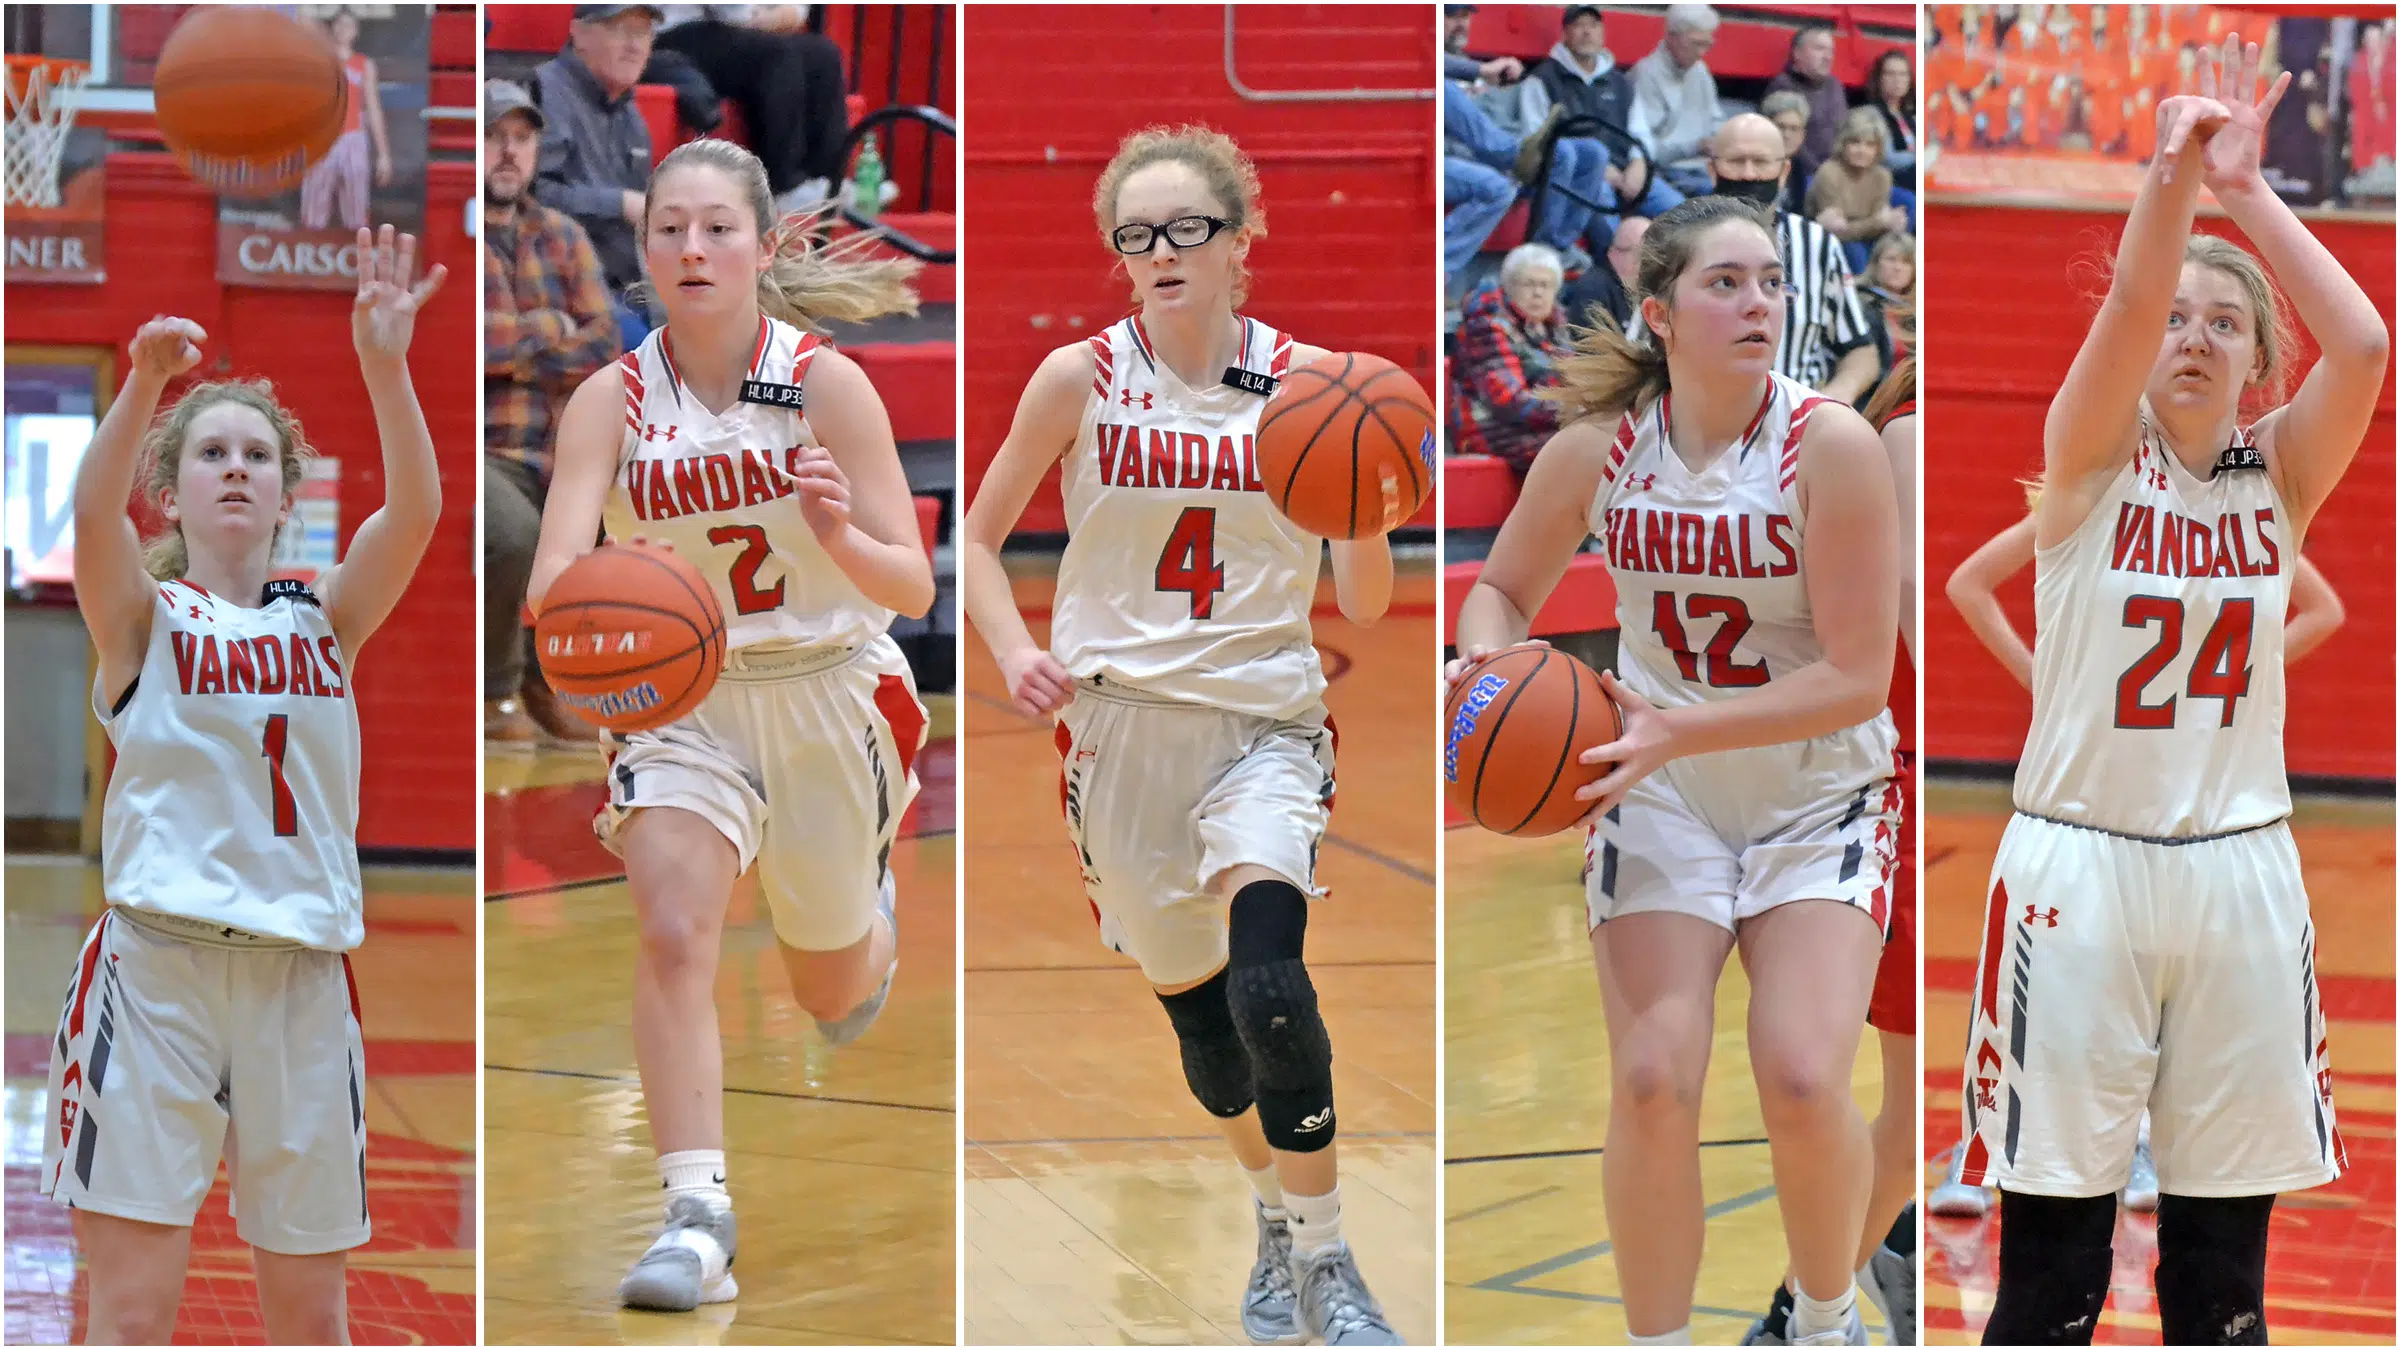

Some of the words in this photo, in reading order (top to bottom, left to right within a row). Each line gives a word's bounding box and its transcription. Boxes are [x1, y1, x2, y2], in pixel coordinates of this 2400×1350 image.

[4, 234, 88, 270] NER
[239, 234, 394, 278] CARSO
[748, 384, 775, 400] HL14
[1240, 372, 1265, 391] HL14
[1097, 423, 1265, 492] VANDAL
[707, 524, 786, 616] 2
[1155, 506, 1225, 620] 4
[1604, 507, 1798, 579] VANDALS
[2110, 501, 2280, 579] VANDALS
[270, 581, 297, 593] HL14
[171, 631, 344, 698] VANDALS
[1652, 590, 1771, 688] 12
[2114, 594, 2255, 729] 24
[261, 714, 298, 836] 1
